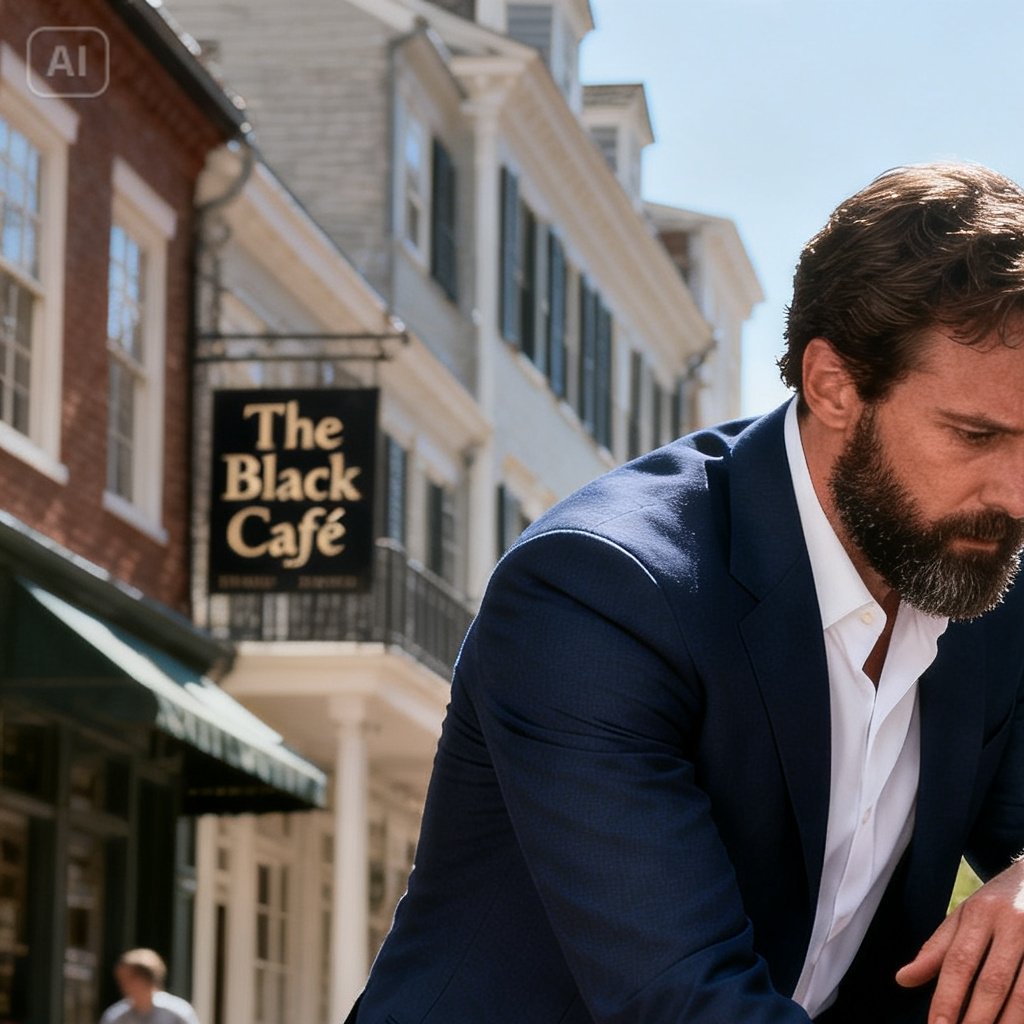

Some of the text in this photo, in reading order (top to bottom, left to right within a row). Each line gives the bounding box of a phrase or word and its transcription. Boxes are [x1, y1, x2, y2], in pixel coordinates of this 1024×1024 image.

[243, 399, 345, 451] The
[222, 450, 363, 502] Black
[226, 505, 347, 569] Café
